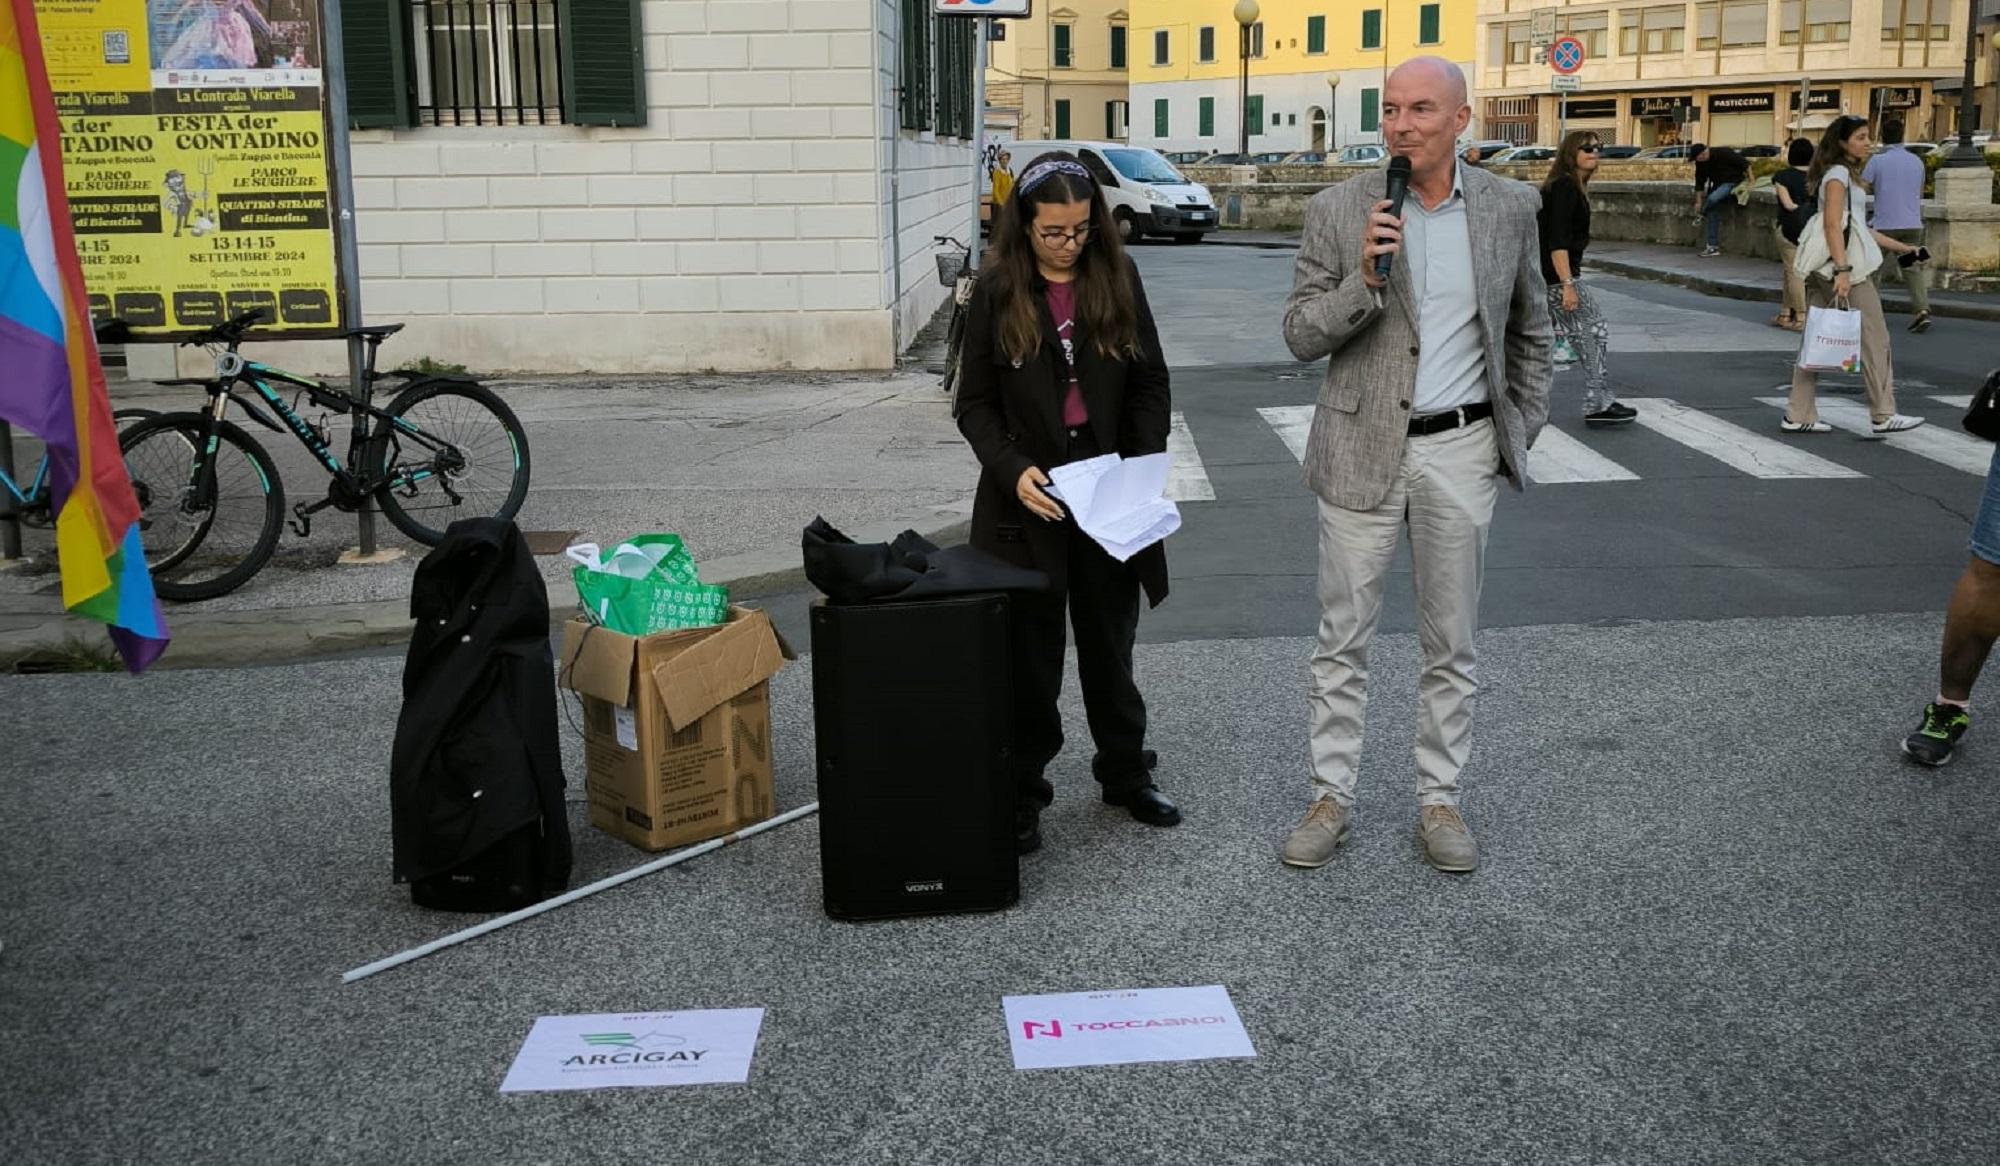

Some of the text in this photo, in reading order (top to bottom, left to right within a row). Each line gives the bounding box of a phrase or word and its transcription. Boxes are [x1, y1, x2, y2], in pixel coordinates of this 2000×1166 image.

[177, 86, 296, 103] La Contrada Viarella
[1806, 93, 1828, 103] AFFÈ
[1714, 98, 1769, 107] PASTICCERIA
[72, 119, 112, 133] der
[157, 115, 279, 132] FESTA der
[176, 131, 319, 150] CONTADINO
[240, 152, 272, 163] Zuppa
[281, 150, 321, 160] Baccalà
[85, 170, 131, 182] PARCO
[251, 167, 297, 178] PARCO
[67, 180, 152, 192] LE SUGHERE
[232, 176, 317, 188] LE SUGHERE
[219, 199, 325, 213] QUATTRO STRADE
[241, 213, 308, 224] di Bientina
[109, 254, 140, 265] 2024
[189, 251, 305, 263] SETTEMBRE 2024
[561, 1049, 710, 1066] ARCIGAY
